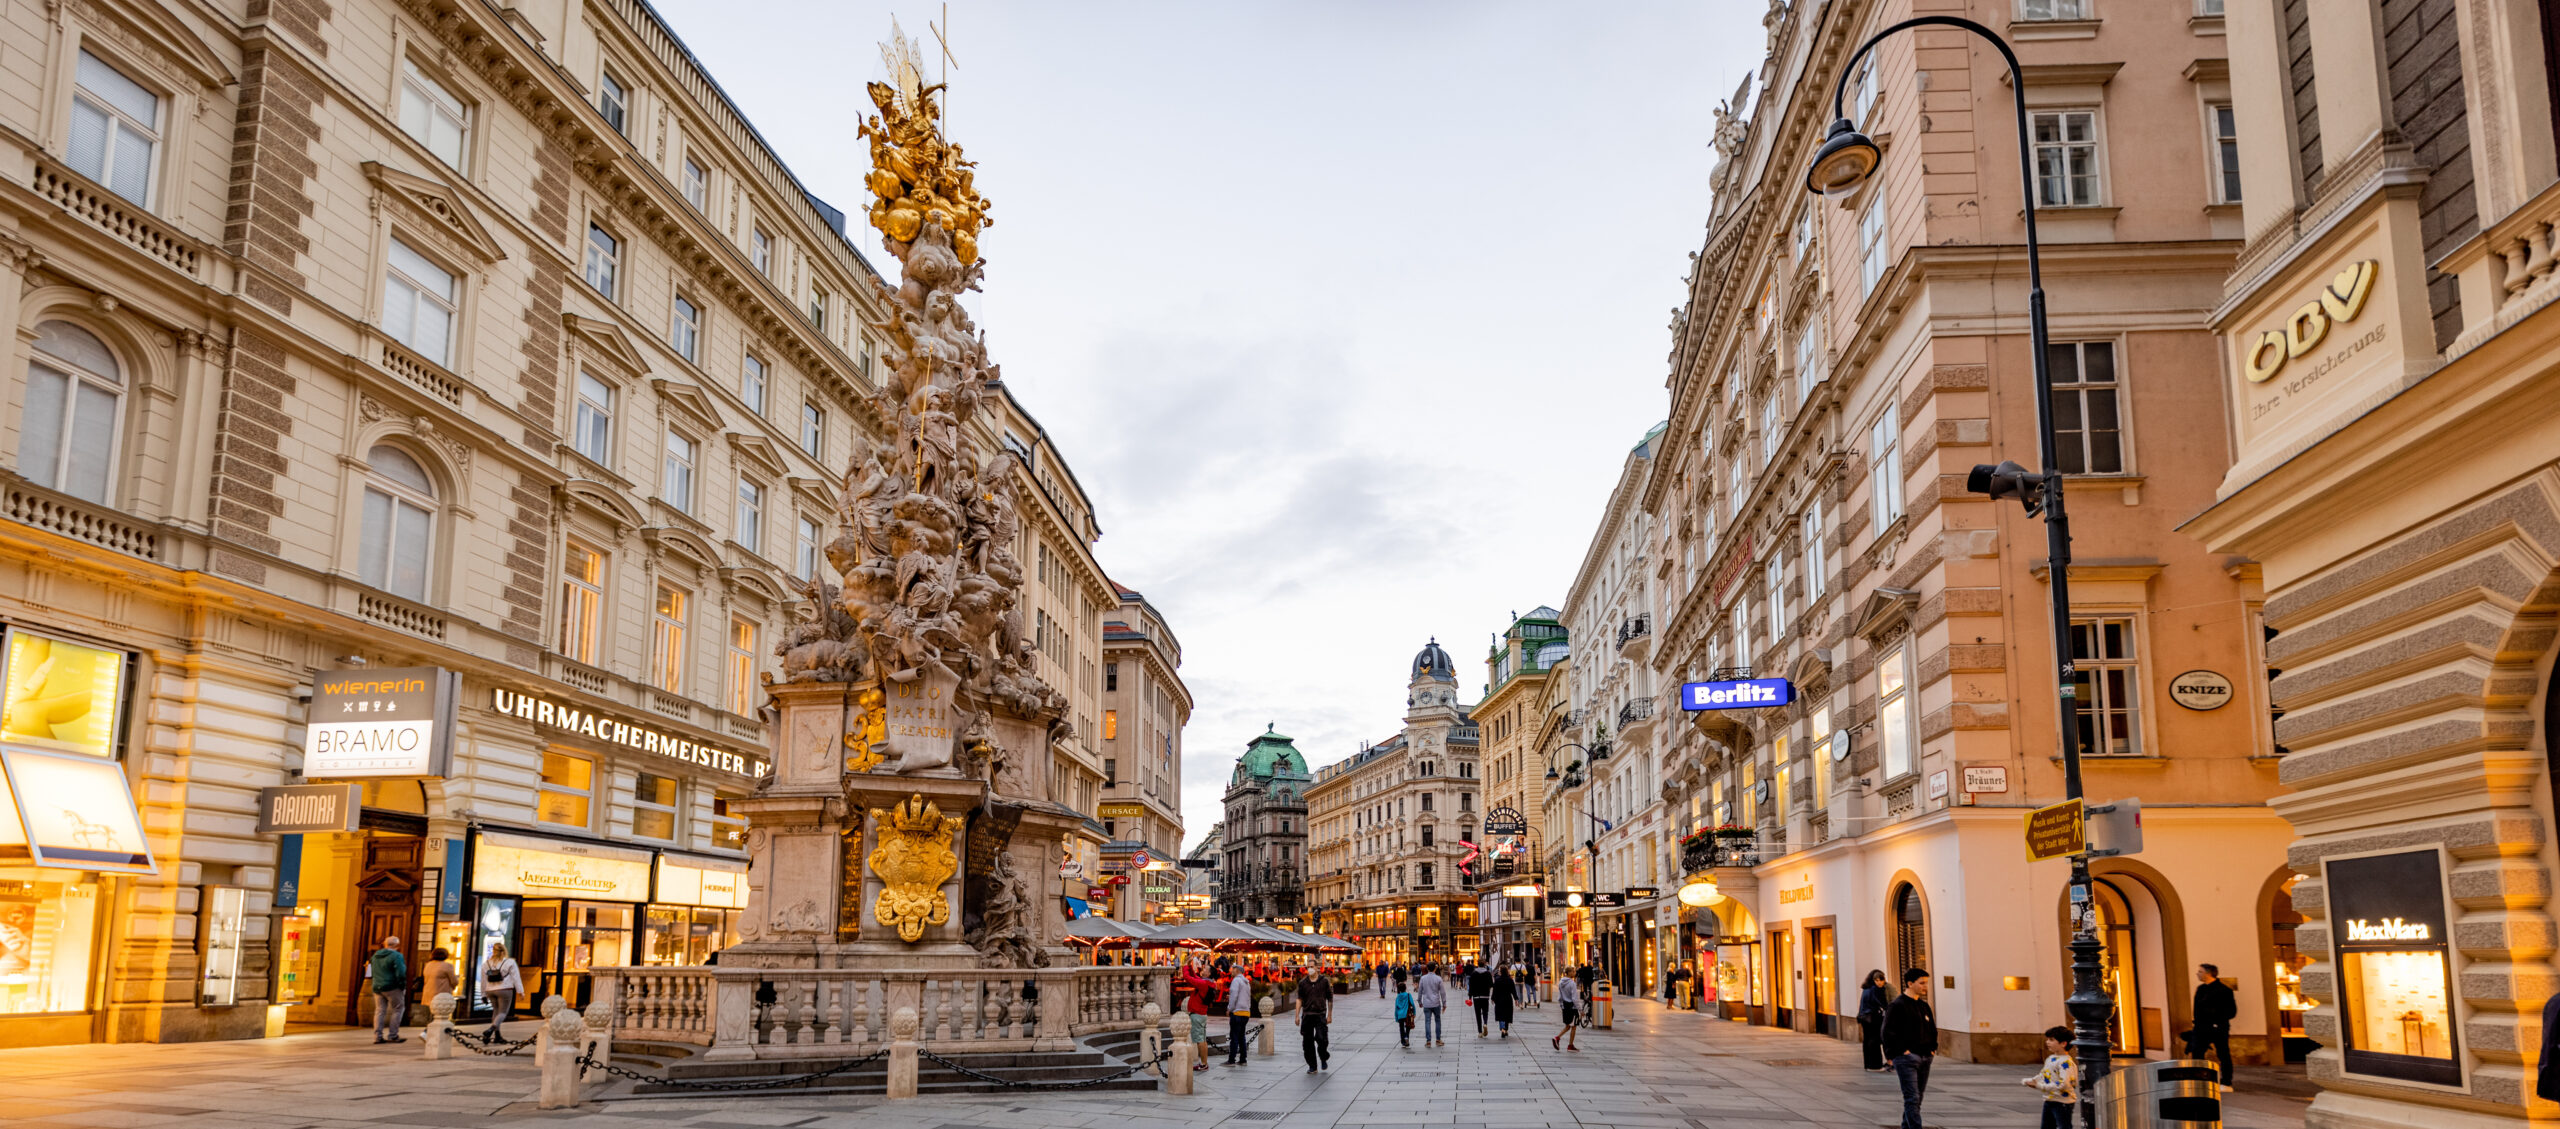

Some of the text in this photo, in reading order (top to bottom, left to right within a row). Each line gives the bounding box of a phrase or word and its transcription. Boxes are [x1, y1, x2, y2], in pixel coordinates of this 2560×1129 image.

[2253, 323, 2386, 421] Ihre Versicherung
[323, 678, 425, 695] wienerin
[899, 683, 940, 700] DEO
[1694, 682, 1776, 704] Berlitz
[2177, 685, 2227, 695] KNIZE
[893, 706, 945, 721] PATRI
[495, 688, 744, 774] UHRMACHERMEISTER
[317, 727, 419, 753] BRAMO
[2033, 812, 2070, 828] Musik und Kunst
[2037, 836, 2069, 851] der Stadt Wien
[1145, 886, 1171, 894] DOUGLAS
[2346, 917, 2430, 941] MaxMara
